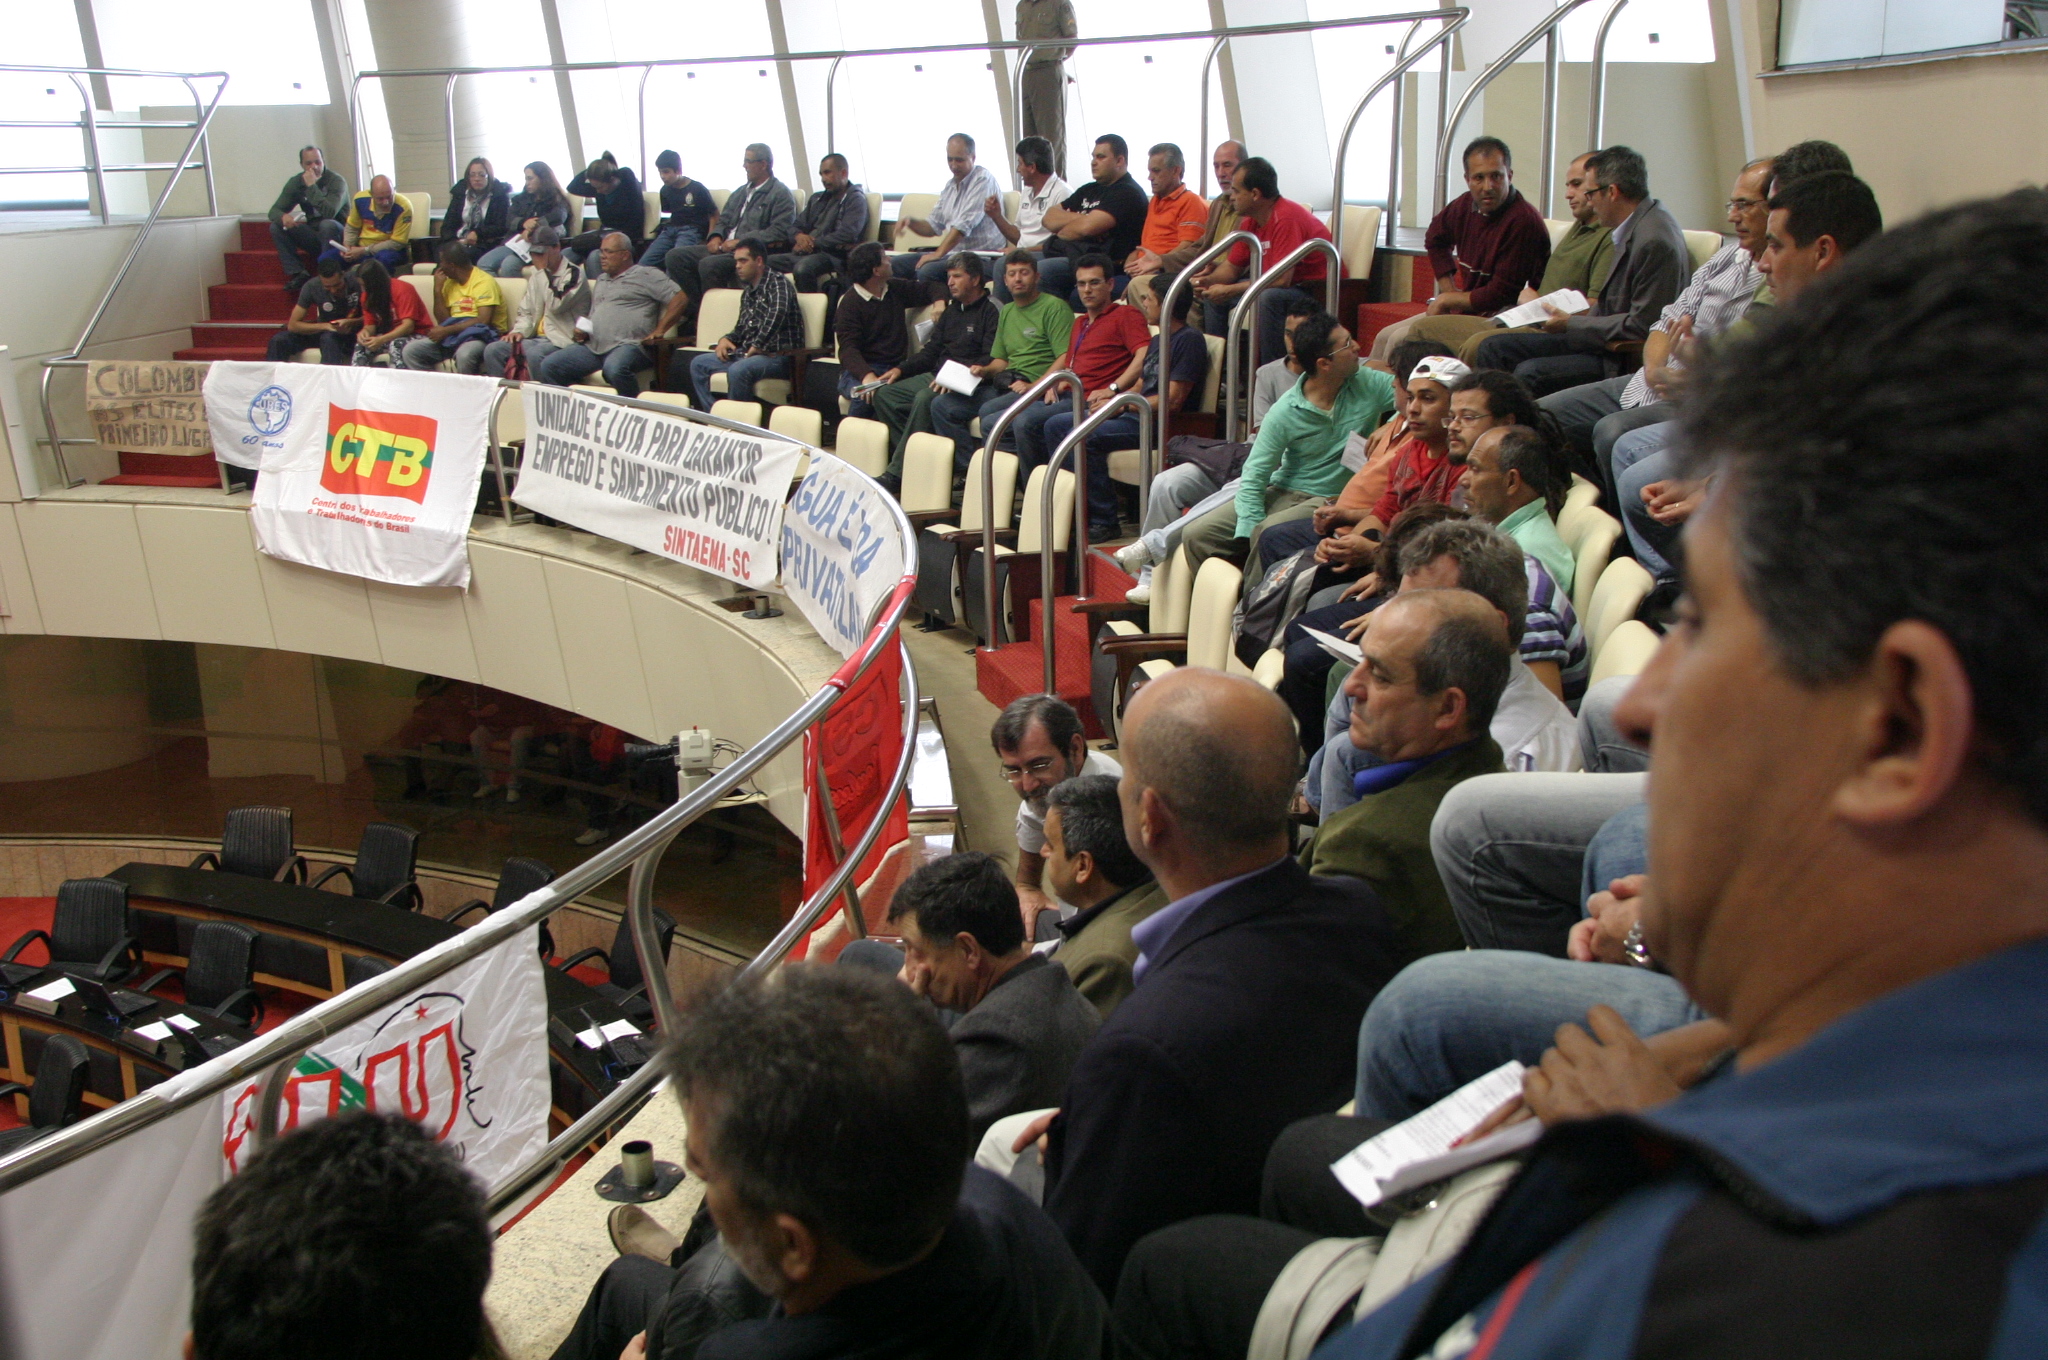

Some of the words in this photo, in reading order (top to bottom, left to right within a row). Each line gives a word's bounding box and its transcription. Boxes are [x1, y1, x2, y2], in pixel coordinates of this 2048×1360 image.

[242, 435, 259, 444] 60
[330, 422, 429, 487] CTB
[535, 390, 597, 440] UNIDADE
[594, 406, 611, 443] E
[605, 407, 650, 455] LUTA
[649, 420, 687, 468] PARA
[682, 431, 763, 486] GARANTIR
[532, 433, 596, 487] EMPREGO
[595, 453, 607, 491] E
[608, 455, 701, 519] SANEAMENTO
[340, 501, 356, 511] dos
[386, 522, 410, 533] Brasil
